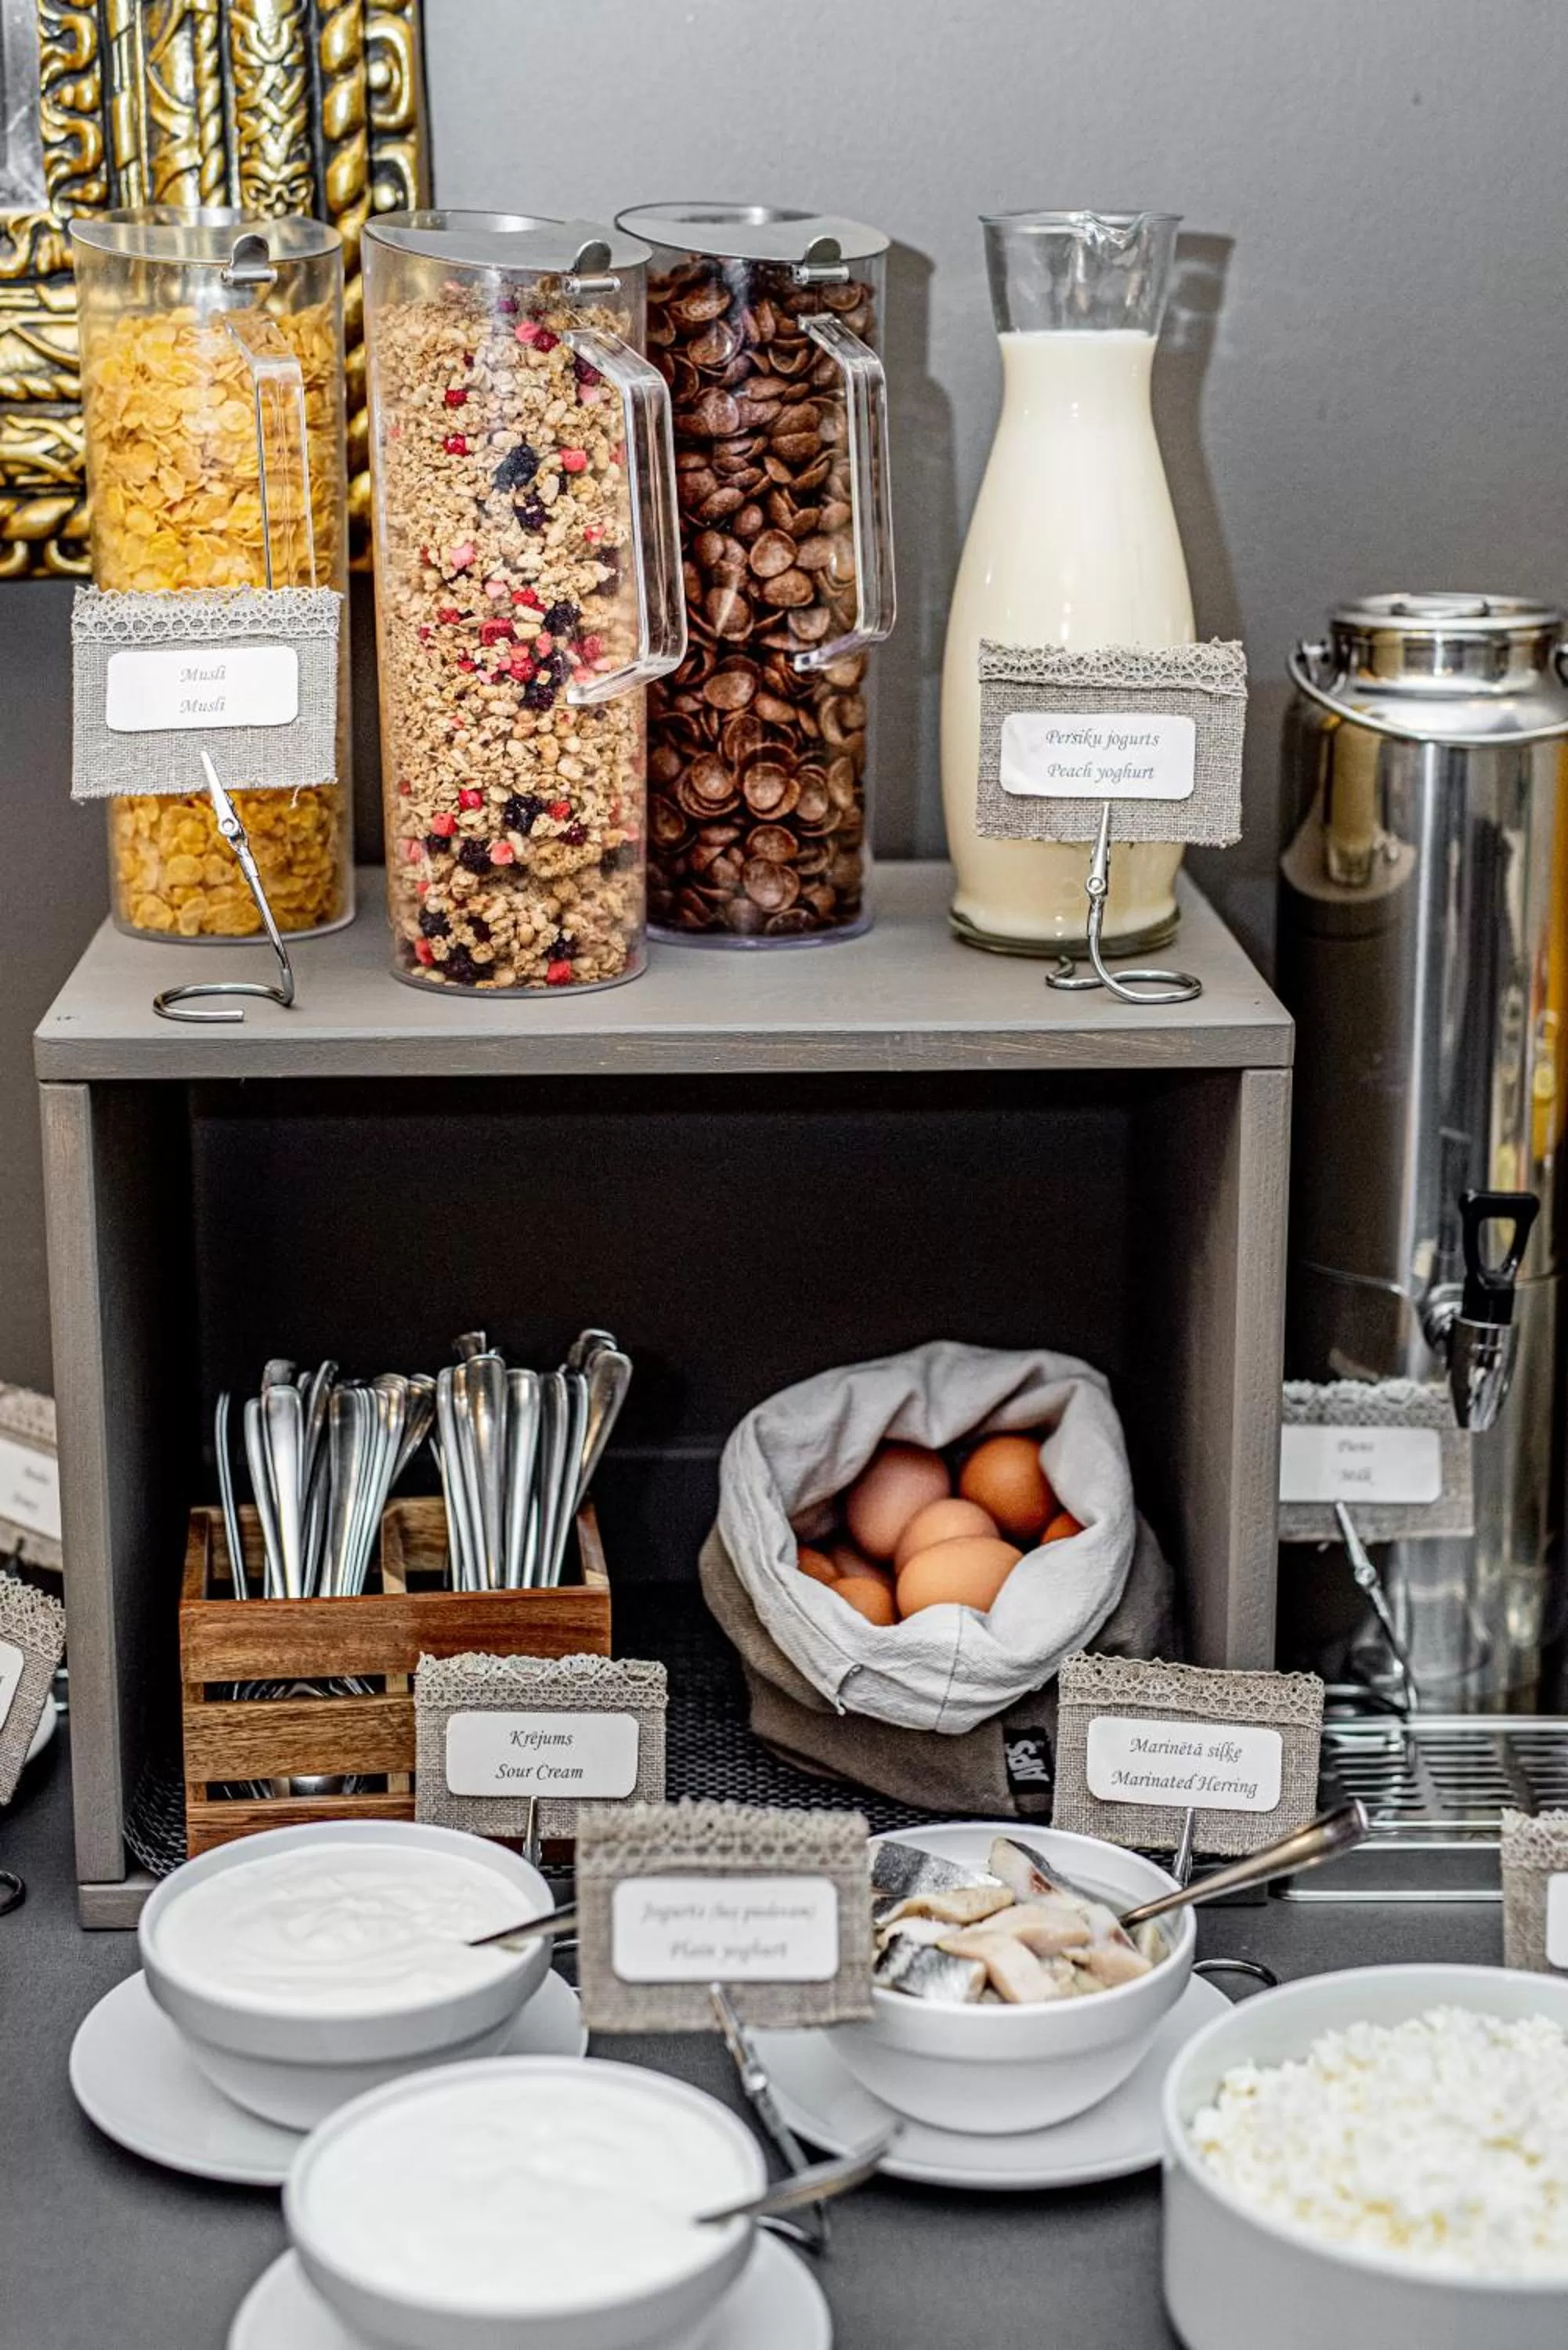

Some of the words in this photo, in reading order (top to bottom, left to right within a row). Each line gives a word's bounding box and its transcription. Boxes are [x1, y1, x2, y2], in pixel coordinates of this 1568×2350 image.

[179, 664, 226, 682] Musli
[179, 696, 226, 714] Musli
[1046, 728, 1102, 749] Persiku
[1104, 730, 1160, 751] jogurts
[1046, 761, 1093, 779] Peach
[1094, 762, 1154, 784] yoghurt
[509, 1730, 574, 1751] Krējums
[1128, 1737, 1202, 1757] Marinētā
[494, 1762, 533, 1780] Sour
[536, 1763, 584, 1780] Cream
[1005, 1740, 1050, 1782] APS
[1110, 1770, 1197, 1791] Marinated
[1196, 1775, 1259, 1799] Herring
